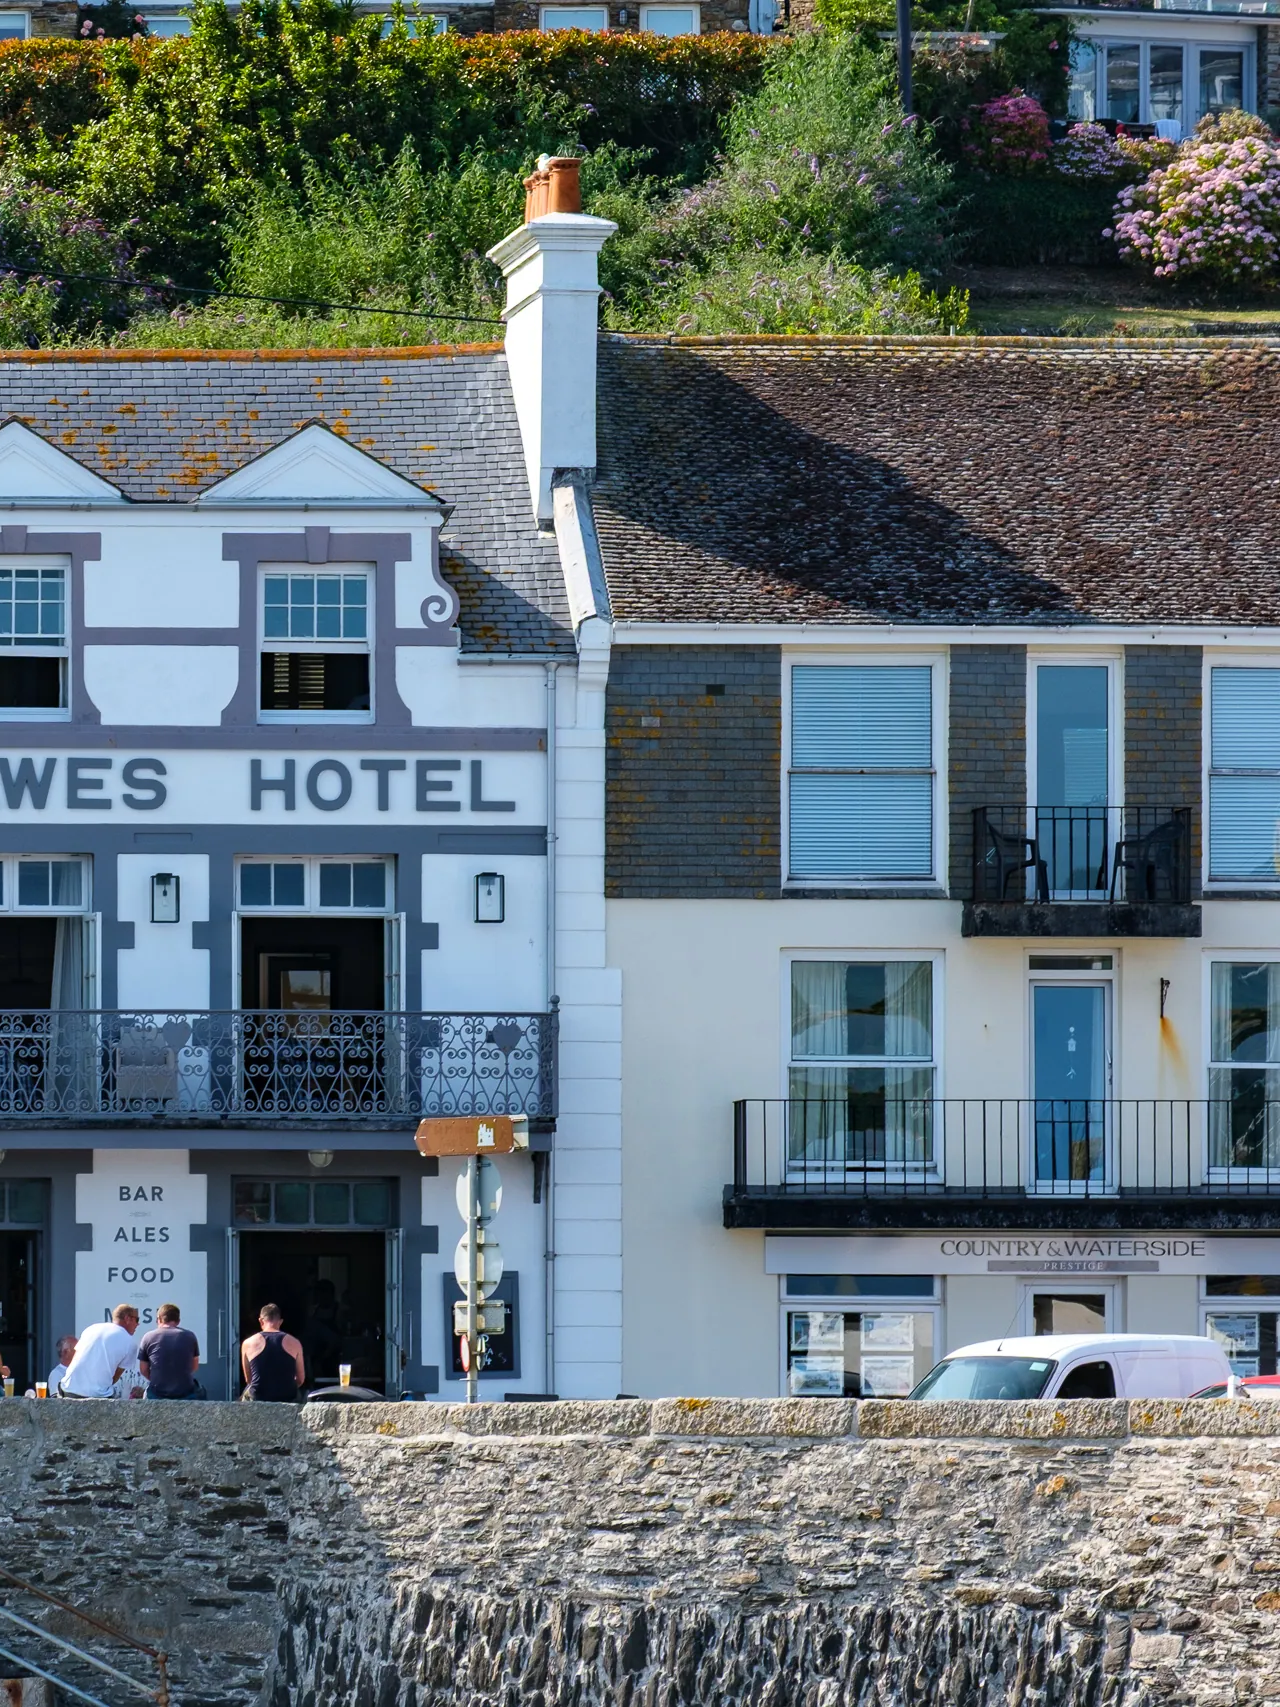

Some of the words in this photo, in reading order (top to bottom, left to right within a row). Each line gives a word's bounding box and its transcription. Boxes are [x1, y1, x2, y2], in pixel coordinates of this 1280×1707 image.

[249, 758, 517, 812] HOTEL
[119, 1185, 164, 1202] BAR
[113, 1226, 170, 1243] ALES
[940, 1239, 1044, 1257] COUNTRY
[1064, 1239, 1206, 1257] WATERSIDE
[107, 1266, 175, 1283] FOOD
[1043, 1261, 1104, 1271] PRESTIGE
